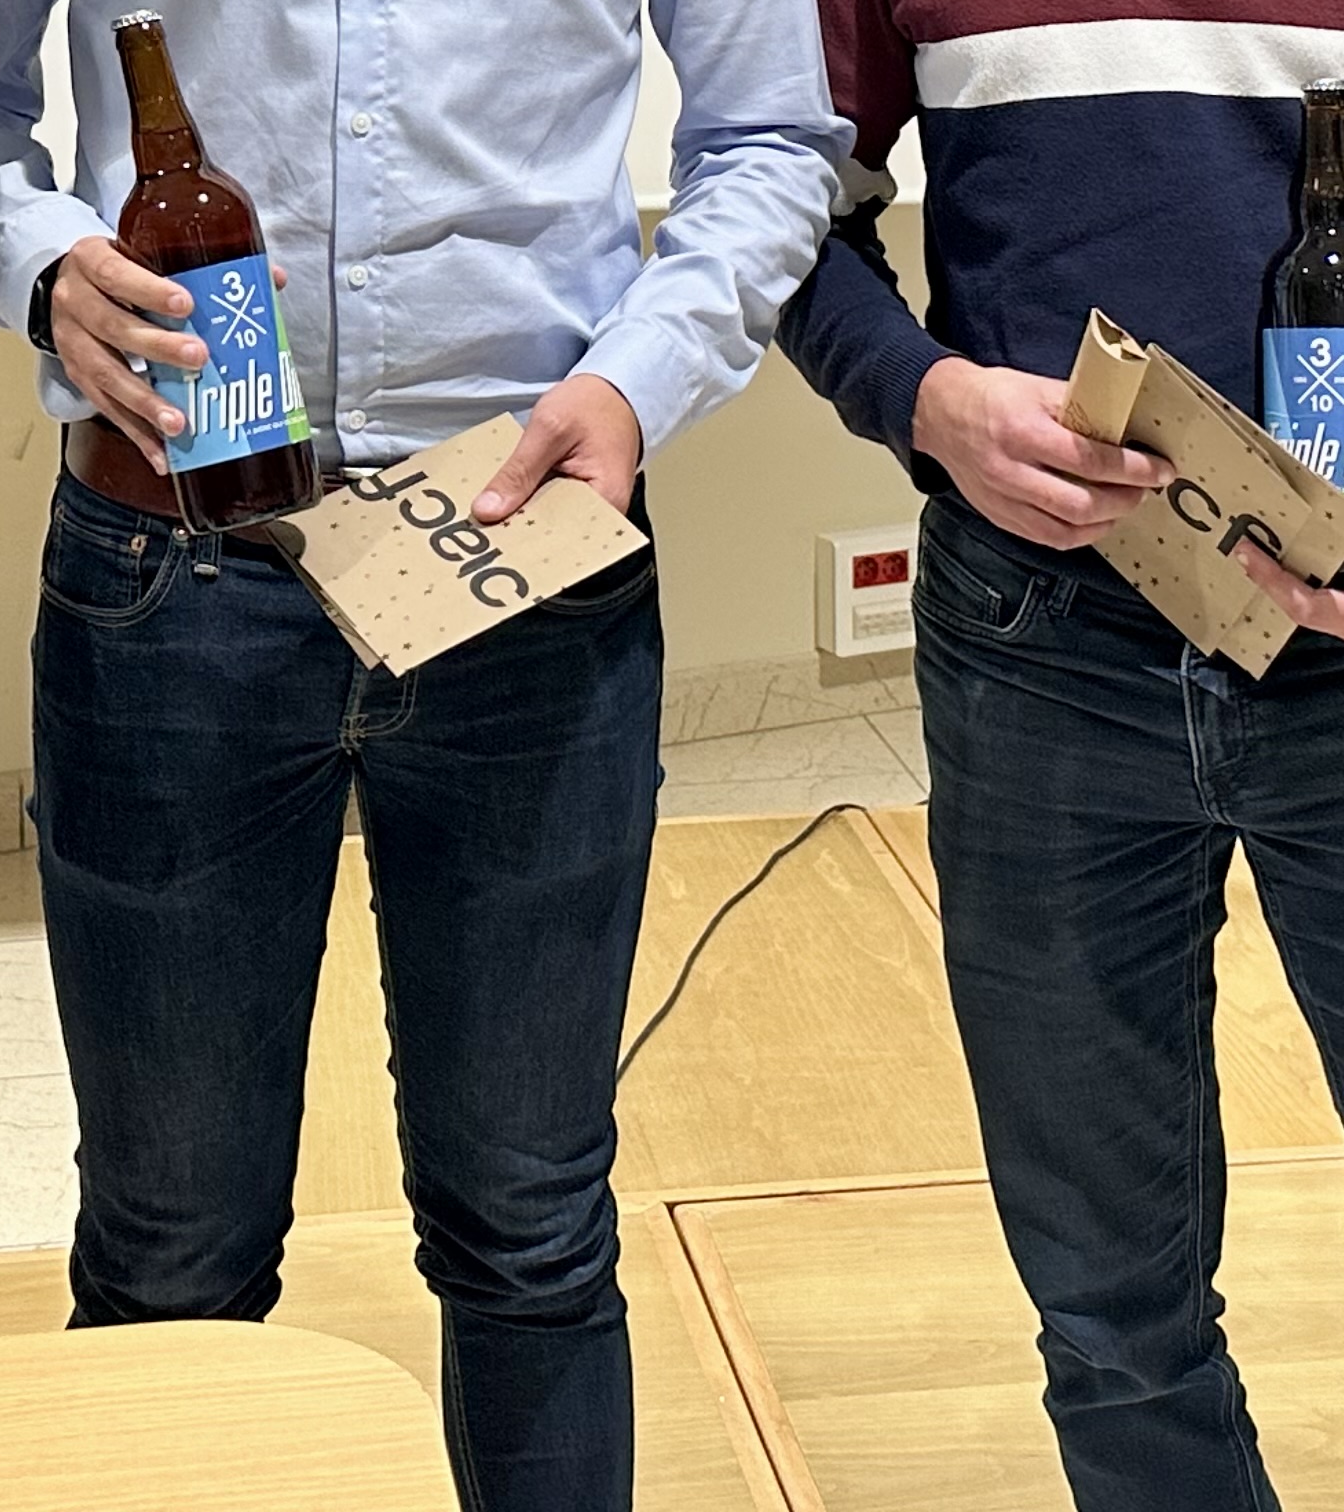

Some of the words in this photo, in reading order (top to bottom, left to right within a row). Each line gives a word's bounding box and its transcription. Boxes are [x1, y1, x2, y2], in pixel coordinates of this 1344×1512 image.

[222, 270, 245, 303] 3
[233, 328, 258, 350] 10
[1309, 337, 1332, 368] 3
[183, 358, 274, 443] Triple
[1309, 394, 1334, 413] 10
[1269, 422, 1341, 480] iple
